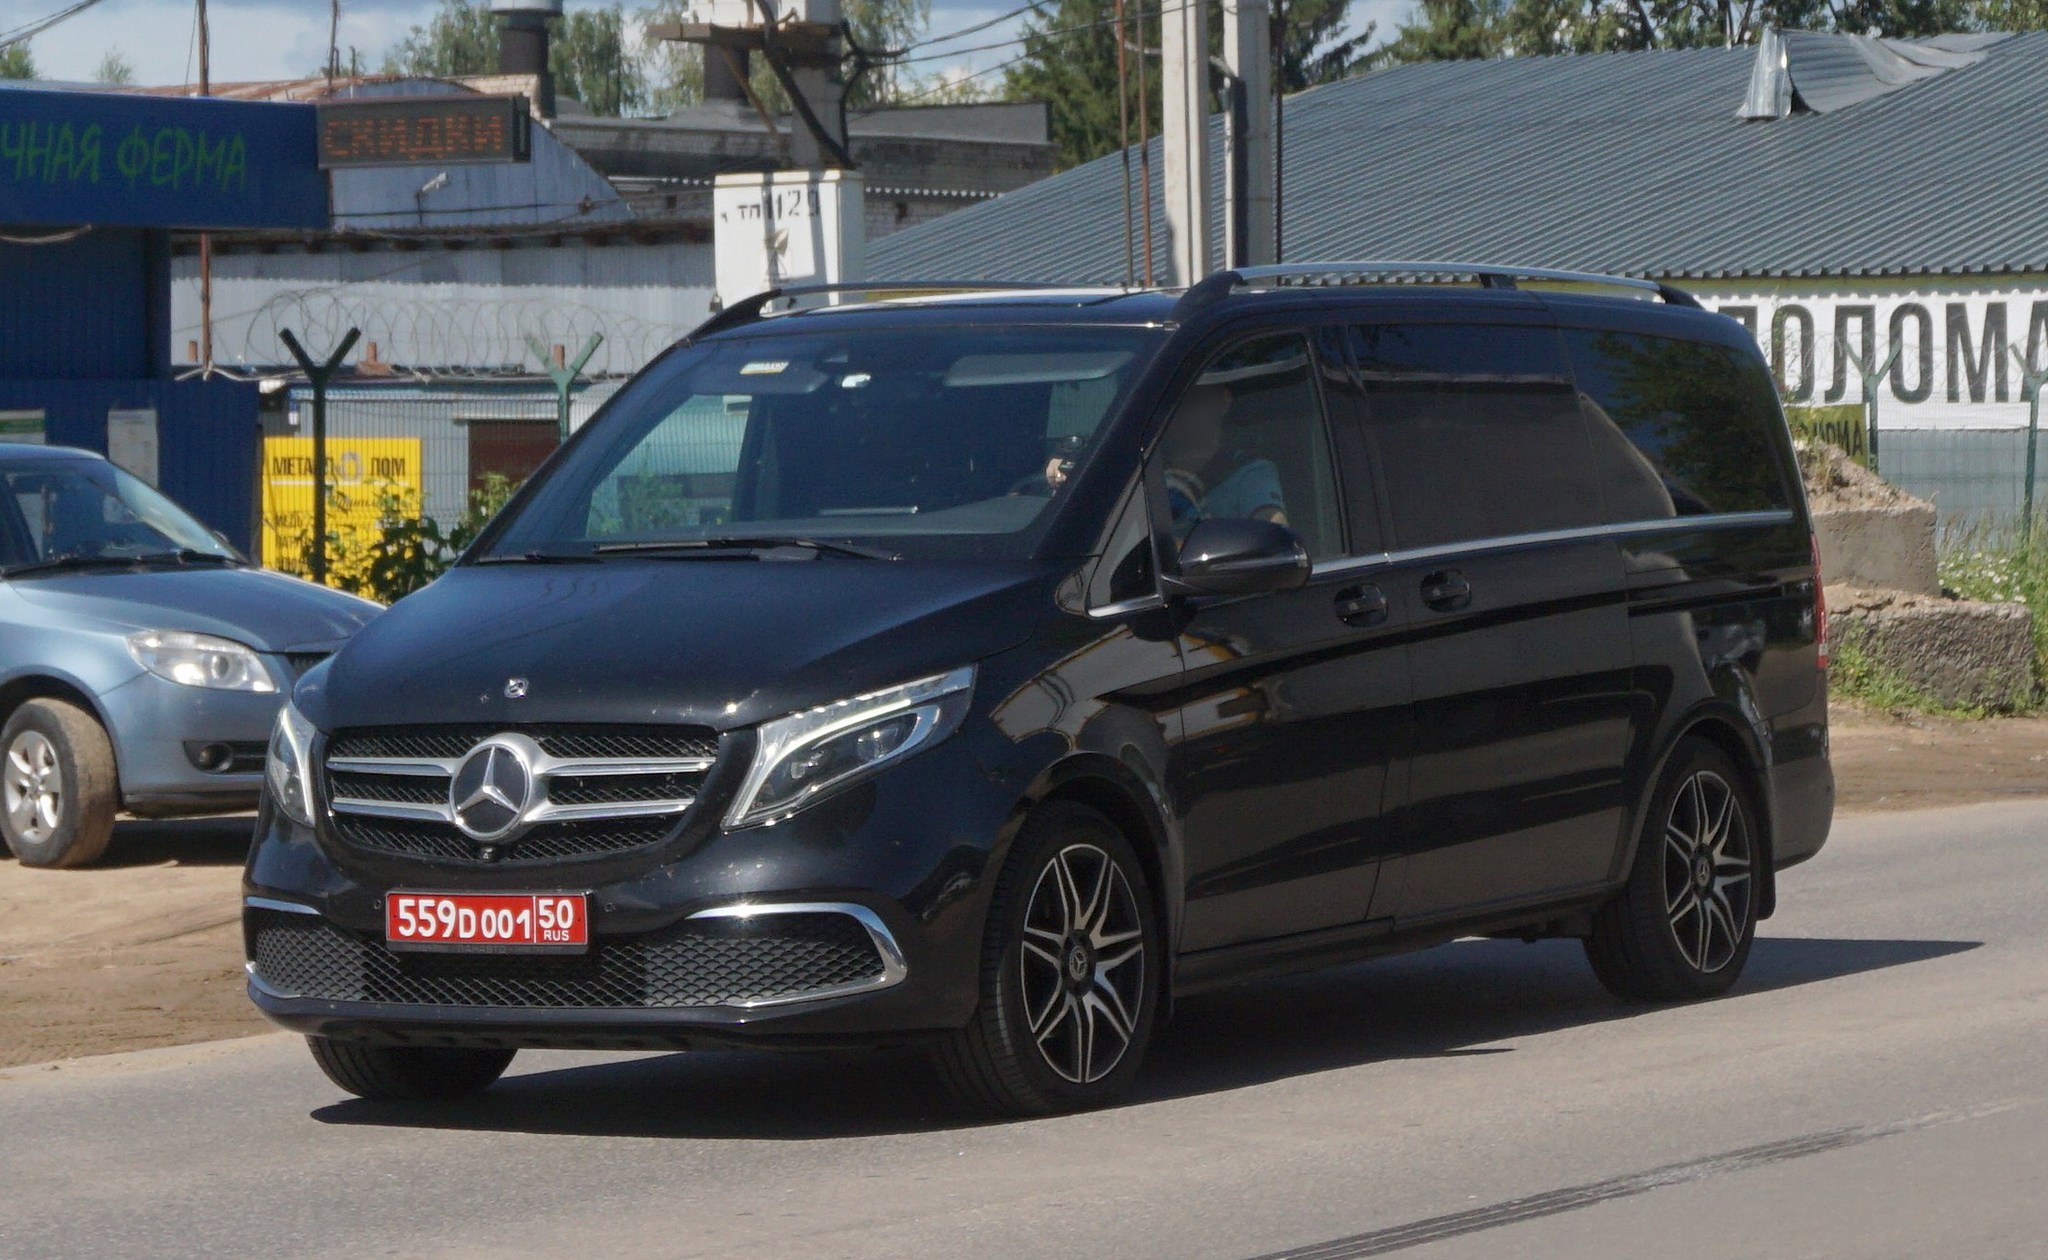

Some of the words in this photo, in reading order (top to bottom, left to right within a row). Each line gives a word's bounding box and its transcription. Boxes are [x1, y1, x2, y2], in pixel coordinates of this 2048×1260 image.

[324, 116, 502, 159] СКИДКИ
[0, 121, 102, 184] ЧНАЯ
[117, 123, 247, 192] ФЕРМА
[538, 899, 574, 929] 50
[543, 930, 570, 941] RUS
